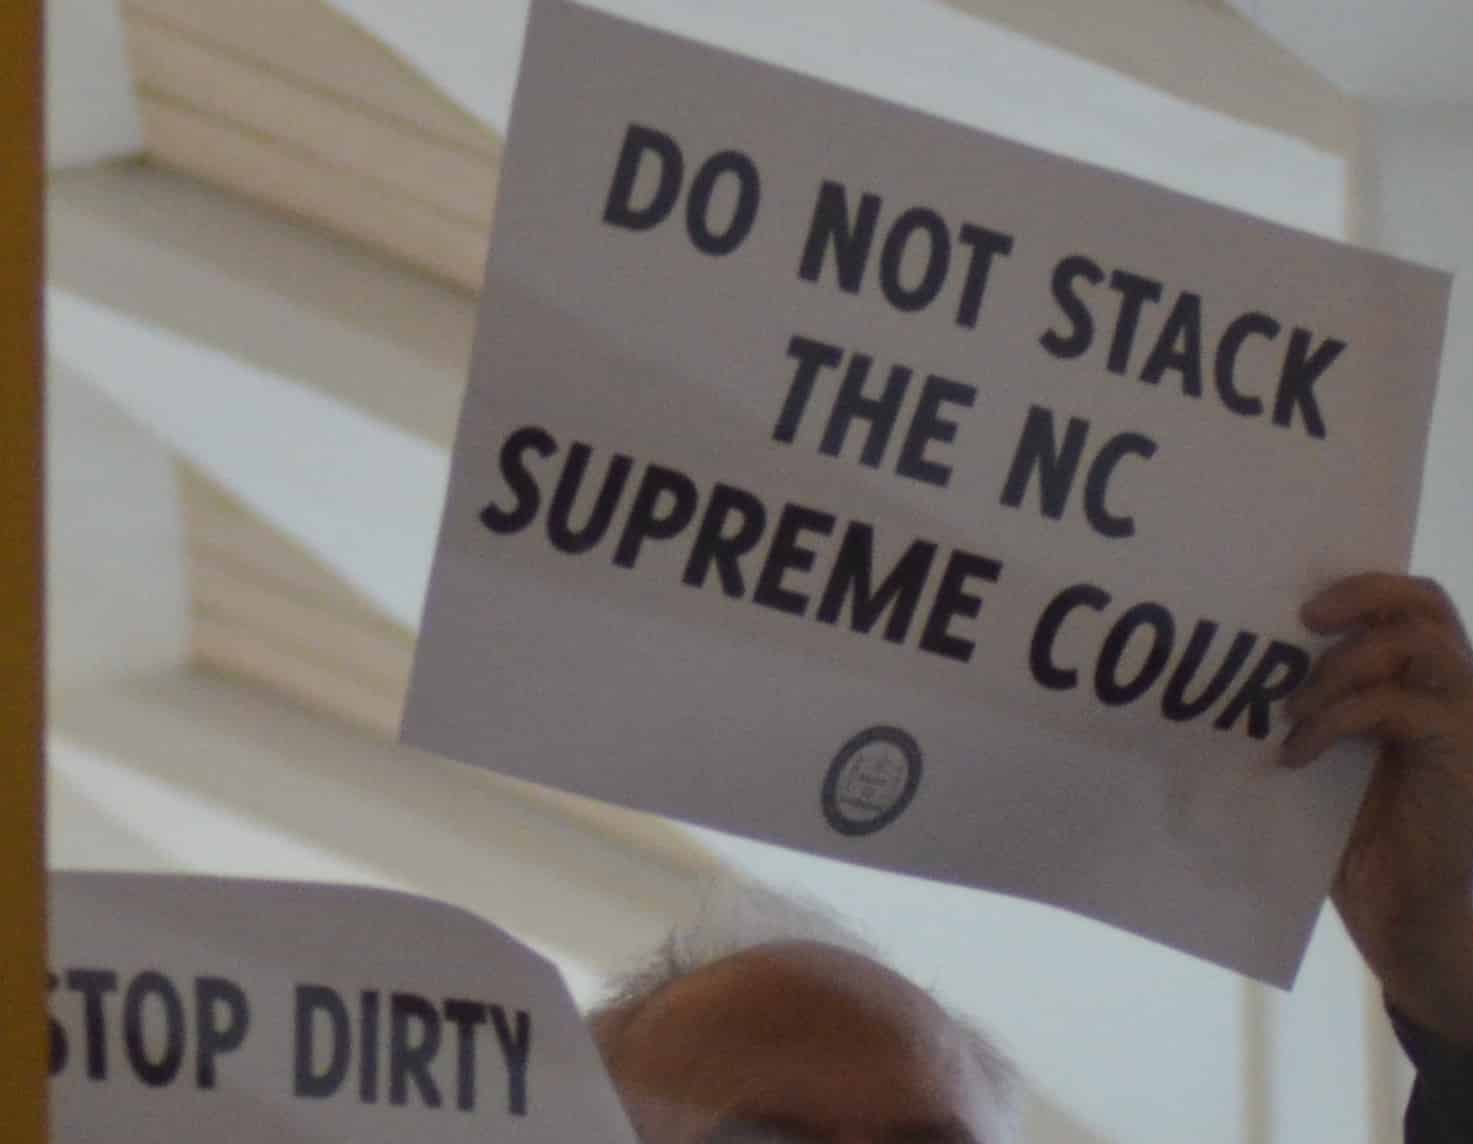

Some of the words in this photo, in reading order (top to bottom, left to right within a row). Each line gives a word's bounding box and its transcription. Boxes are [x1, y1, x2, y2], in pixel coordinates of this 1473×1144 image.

[602, 122, 761, 258] DO
[796, 178, 1014, 330] NOT
[1038, 253, 1348, 440] STACK
[770, 334, 977, 487] THE
[999, 403, 1158, 540] NC
[478, 424, 1003, 664] SUPREME
[1026, 583, 1311, 741] COUR
[292, 983, 532, 1116] DIRTY
